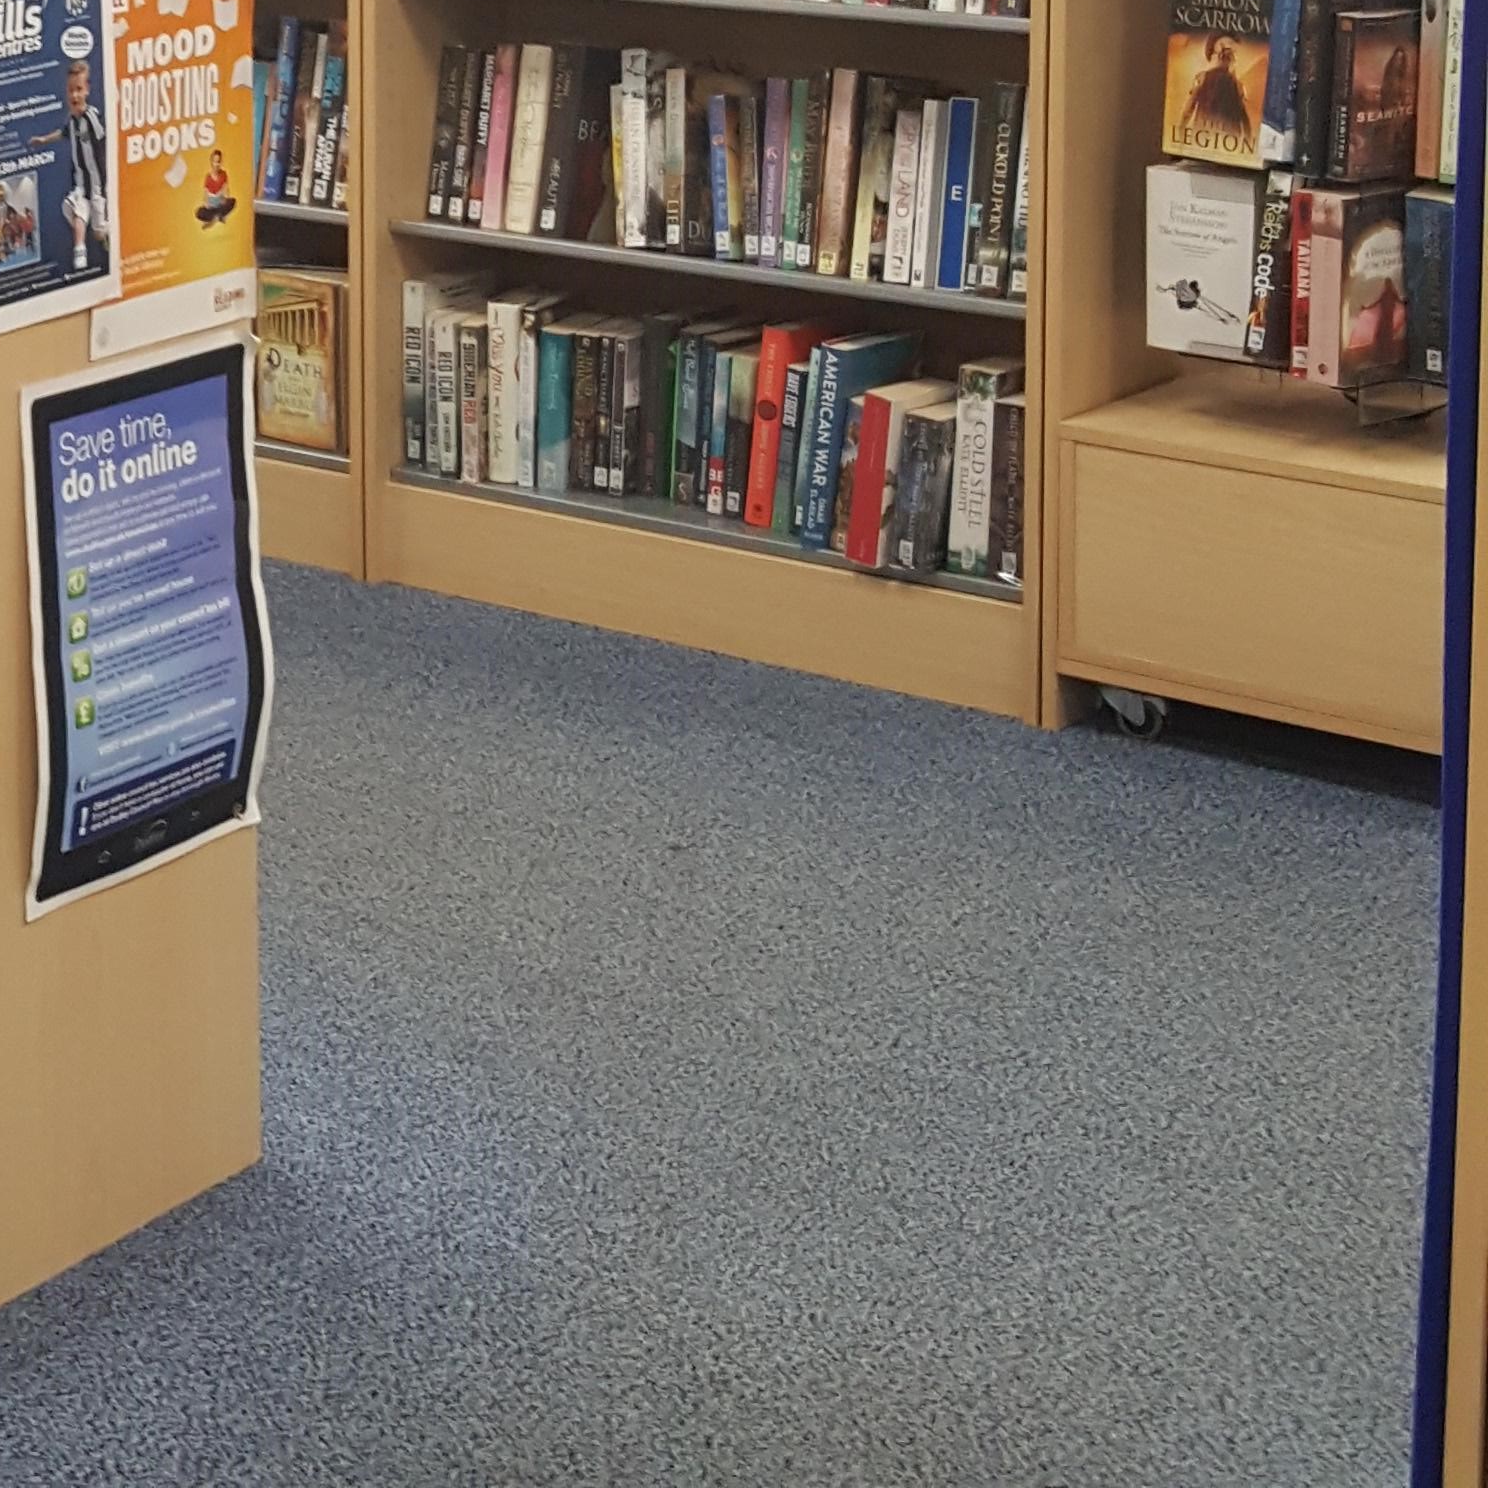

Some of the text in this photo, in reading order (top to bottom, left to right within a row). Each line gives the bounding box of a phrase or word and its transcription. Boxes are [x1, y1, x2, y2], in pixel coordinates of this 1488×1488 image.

[1175, 6, 1272, 34] SCARROW
[127, 24, 215, 74] MOOD
[120, 62, 219, 132] BOOSTING
[18, 150, 56, 173] MARCH
[126, 119, 216, 165] BOOKS
[1170, 125, 1257, 156] LEGION
[986, 122, 1010, 243] CUCKOLD POINT
[1295, 239, 1311, 299] TATIANA
[267, 346, 323, 379] DEATH
[404, 325, 423, 385] RED ICON
[58, 412, 172, 466] Save time,
[810, 351, 841, 487] AMERICAN WAR
[61, 439, 198, 504] do it online
[966, 420, 989, 529] COLD STEEL
